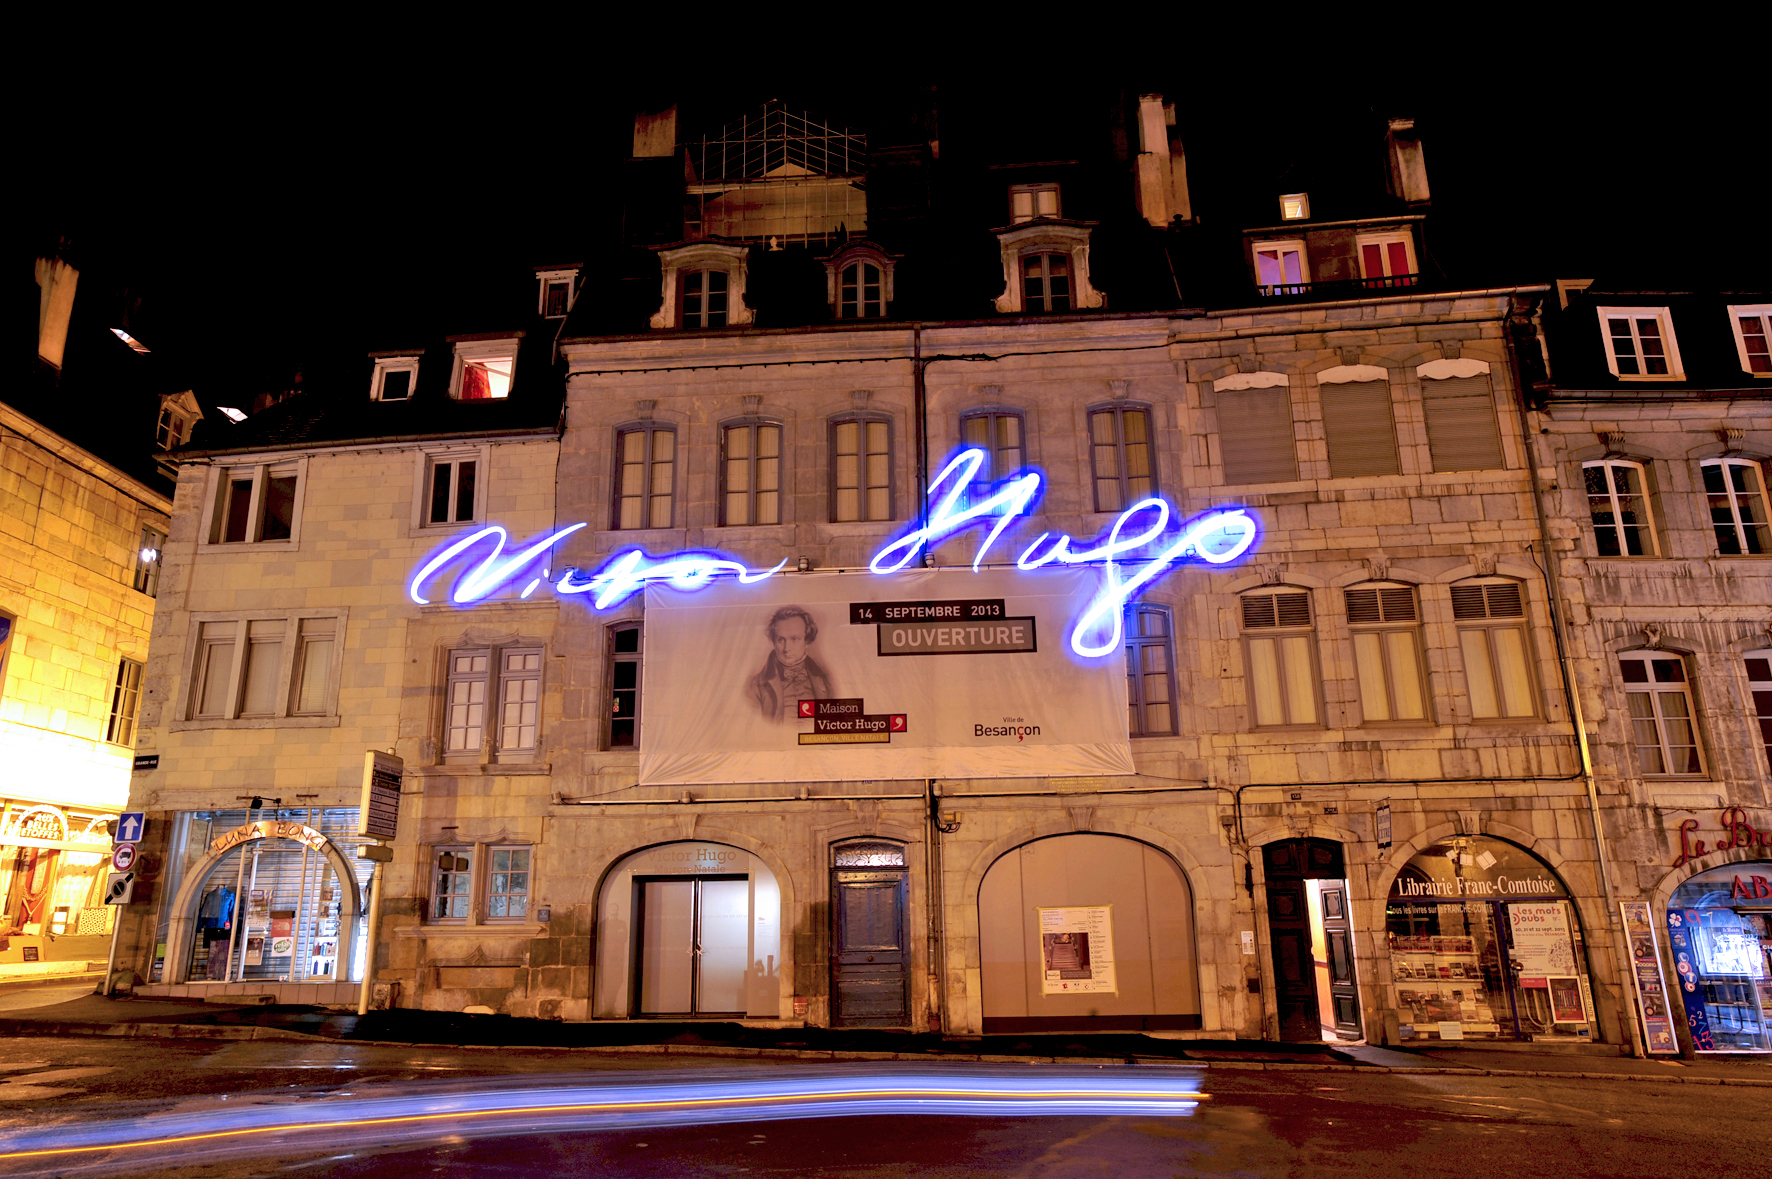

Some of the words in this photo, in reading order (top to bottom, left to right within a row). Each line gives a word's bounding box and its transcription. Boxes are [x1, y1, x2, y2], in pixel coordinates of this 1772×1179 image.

[870, 448, 1256, 657] Hugo
[859, 609, 872, 618] 14
[885, 606, 961, 618] SEPTEMBRE
[971, 605, 1000, 616] 2013
[892, 626, 1025, 647] OUVERTURE
[819, 703, 859, 714] Maison
[817, 720, 853, 730] Victor
[855, 719, 886, 733] Hugo
[974, 723, 1041, 743] Besançon
[34, 814, 55, 822] AUX
[26, 820, 59, 831] BELLES
[20, 828, 59, 839] ETOFFES
[215, 824, 263, 851] LUNA
[277, 822, 324, 849] BONG
[1672, 819, 1710, 868] Le
[648, 850, 692, 862] Victor
[696, 848, 736, 864] Hugo
[694, 864, 726, 873] Natale
[1397, 877, 1453, 896] Librairie
[1456, 875, 1556, 898] Franc-Comtoise
[1389, 905, 1403, 914] Tous
[1403, 905, 1412, 914] les
[1412, 905, 1427, 914] livres
[1427, 906, 1437, 914] sur
[1535, 905, 1561, 915] mots
